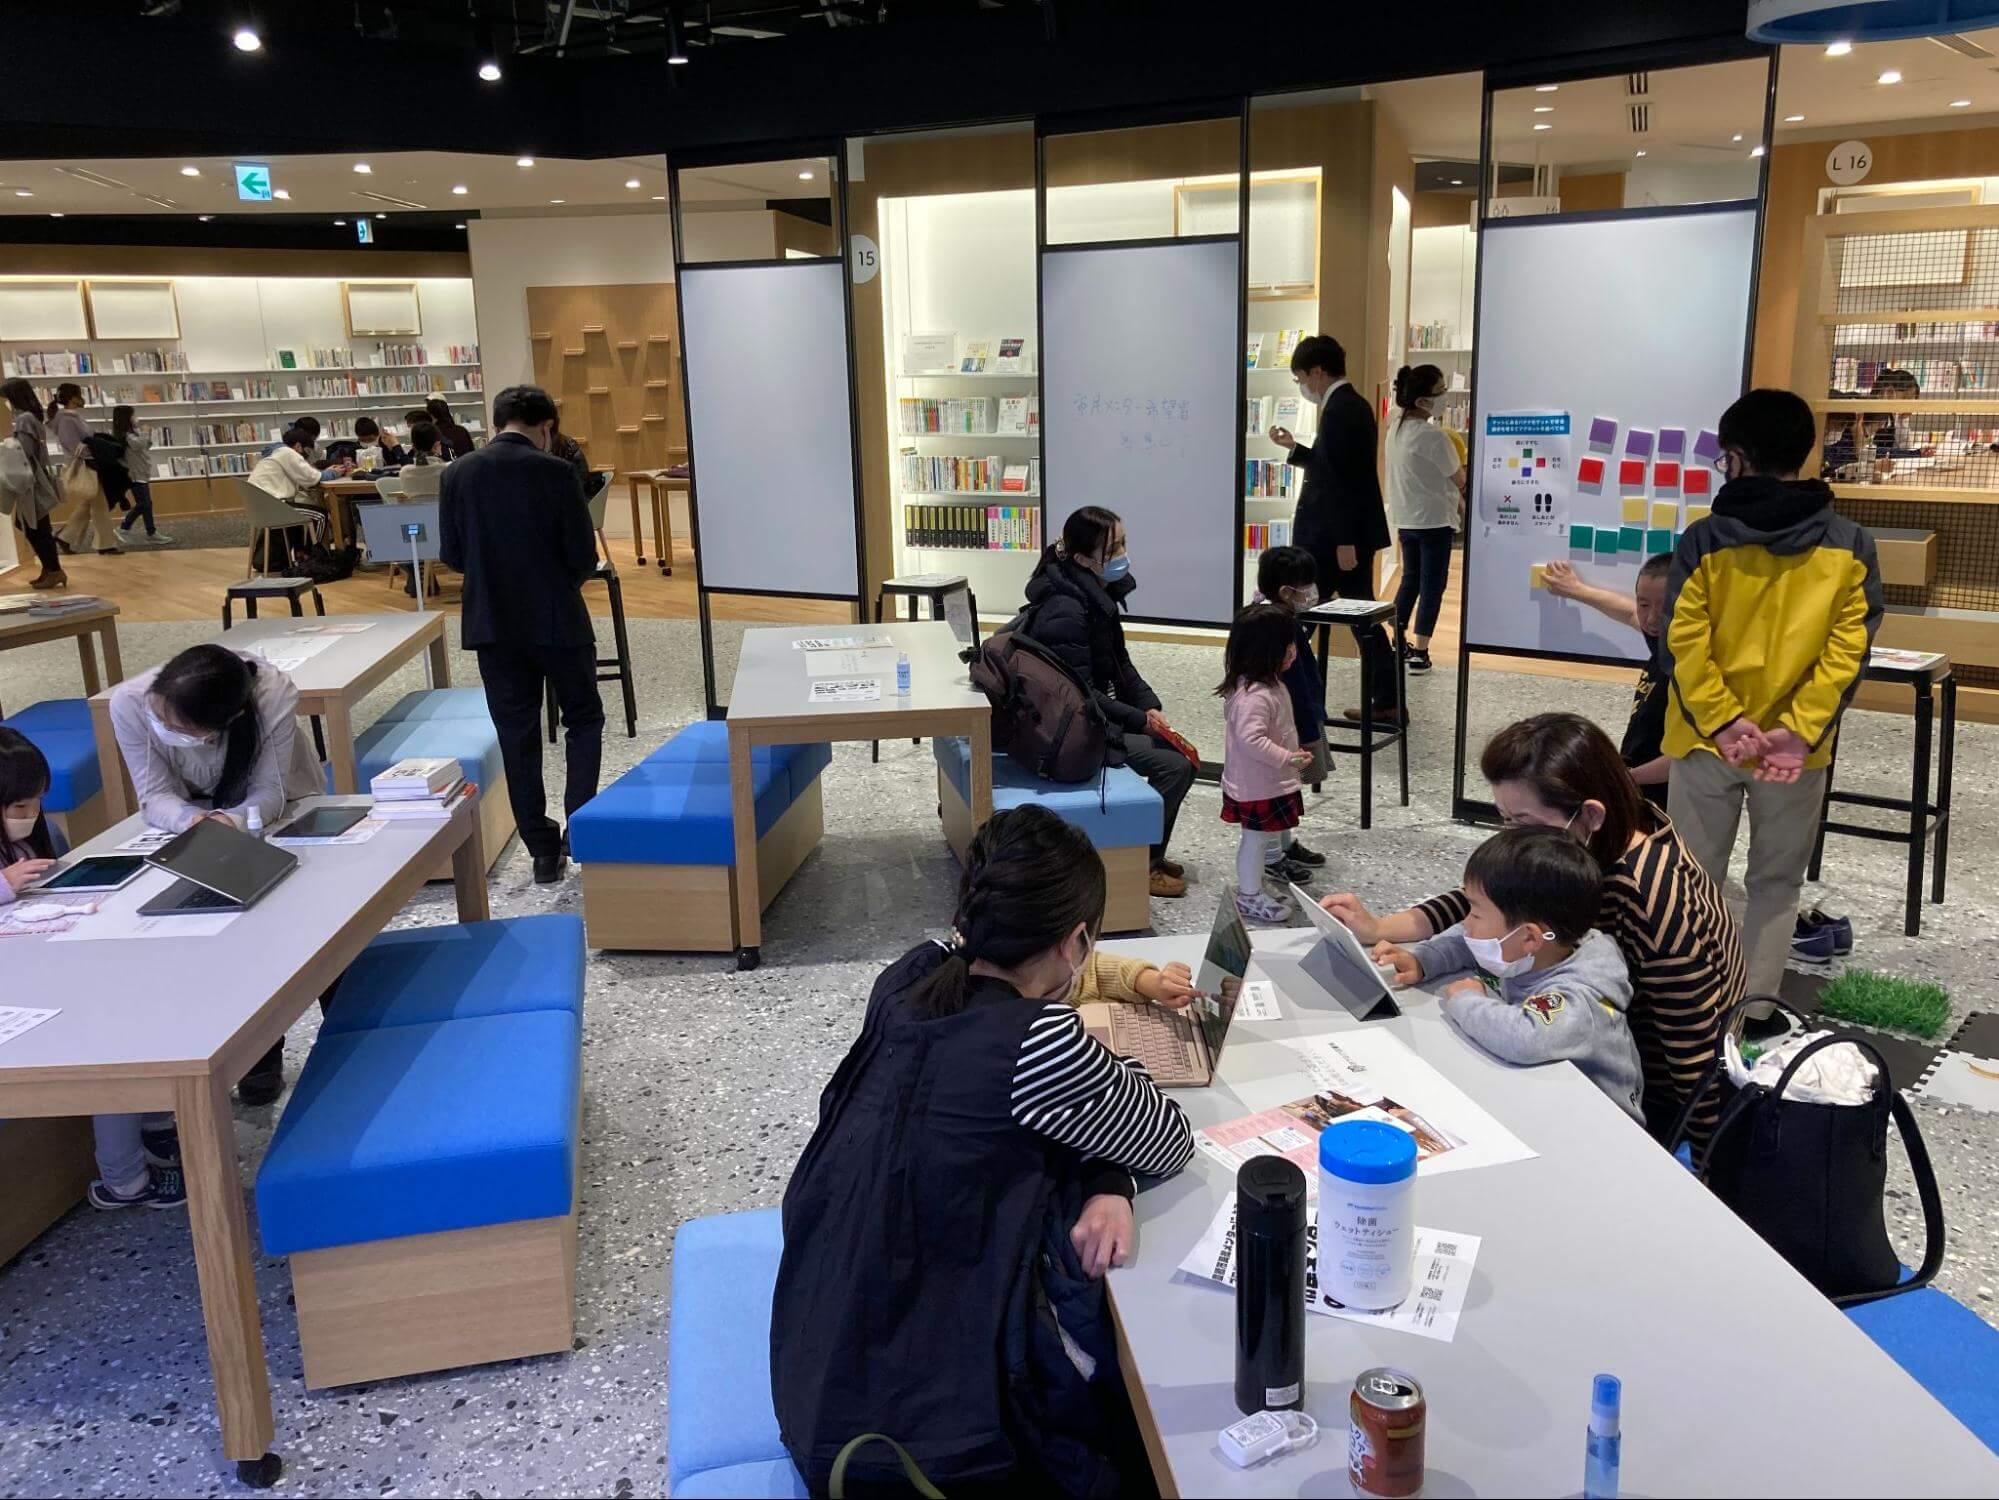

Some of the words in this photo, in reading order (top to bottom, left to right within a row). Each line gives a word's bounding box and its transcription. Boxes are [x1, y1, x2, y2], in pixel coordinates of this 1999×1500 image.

[1833, 157, 1842, 170] L
[1851, 155, 1867, 170] 16
[858, 250, 875, 266] 15
[1356, 1216, 1378, 1227] 除菌
